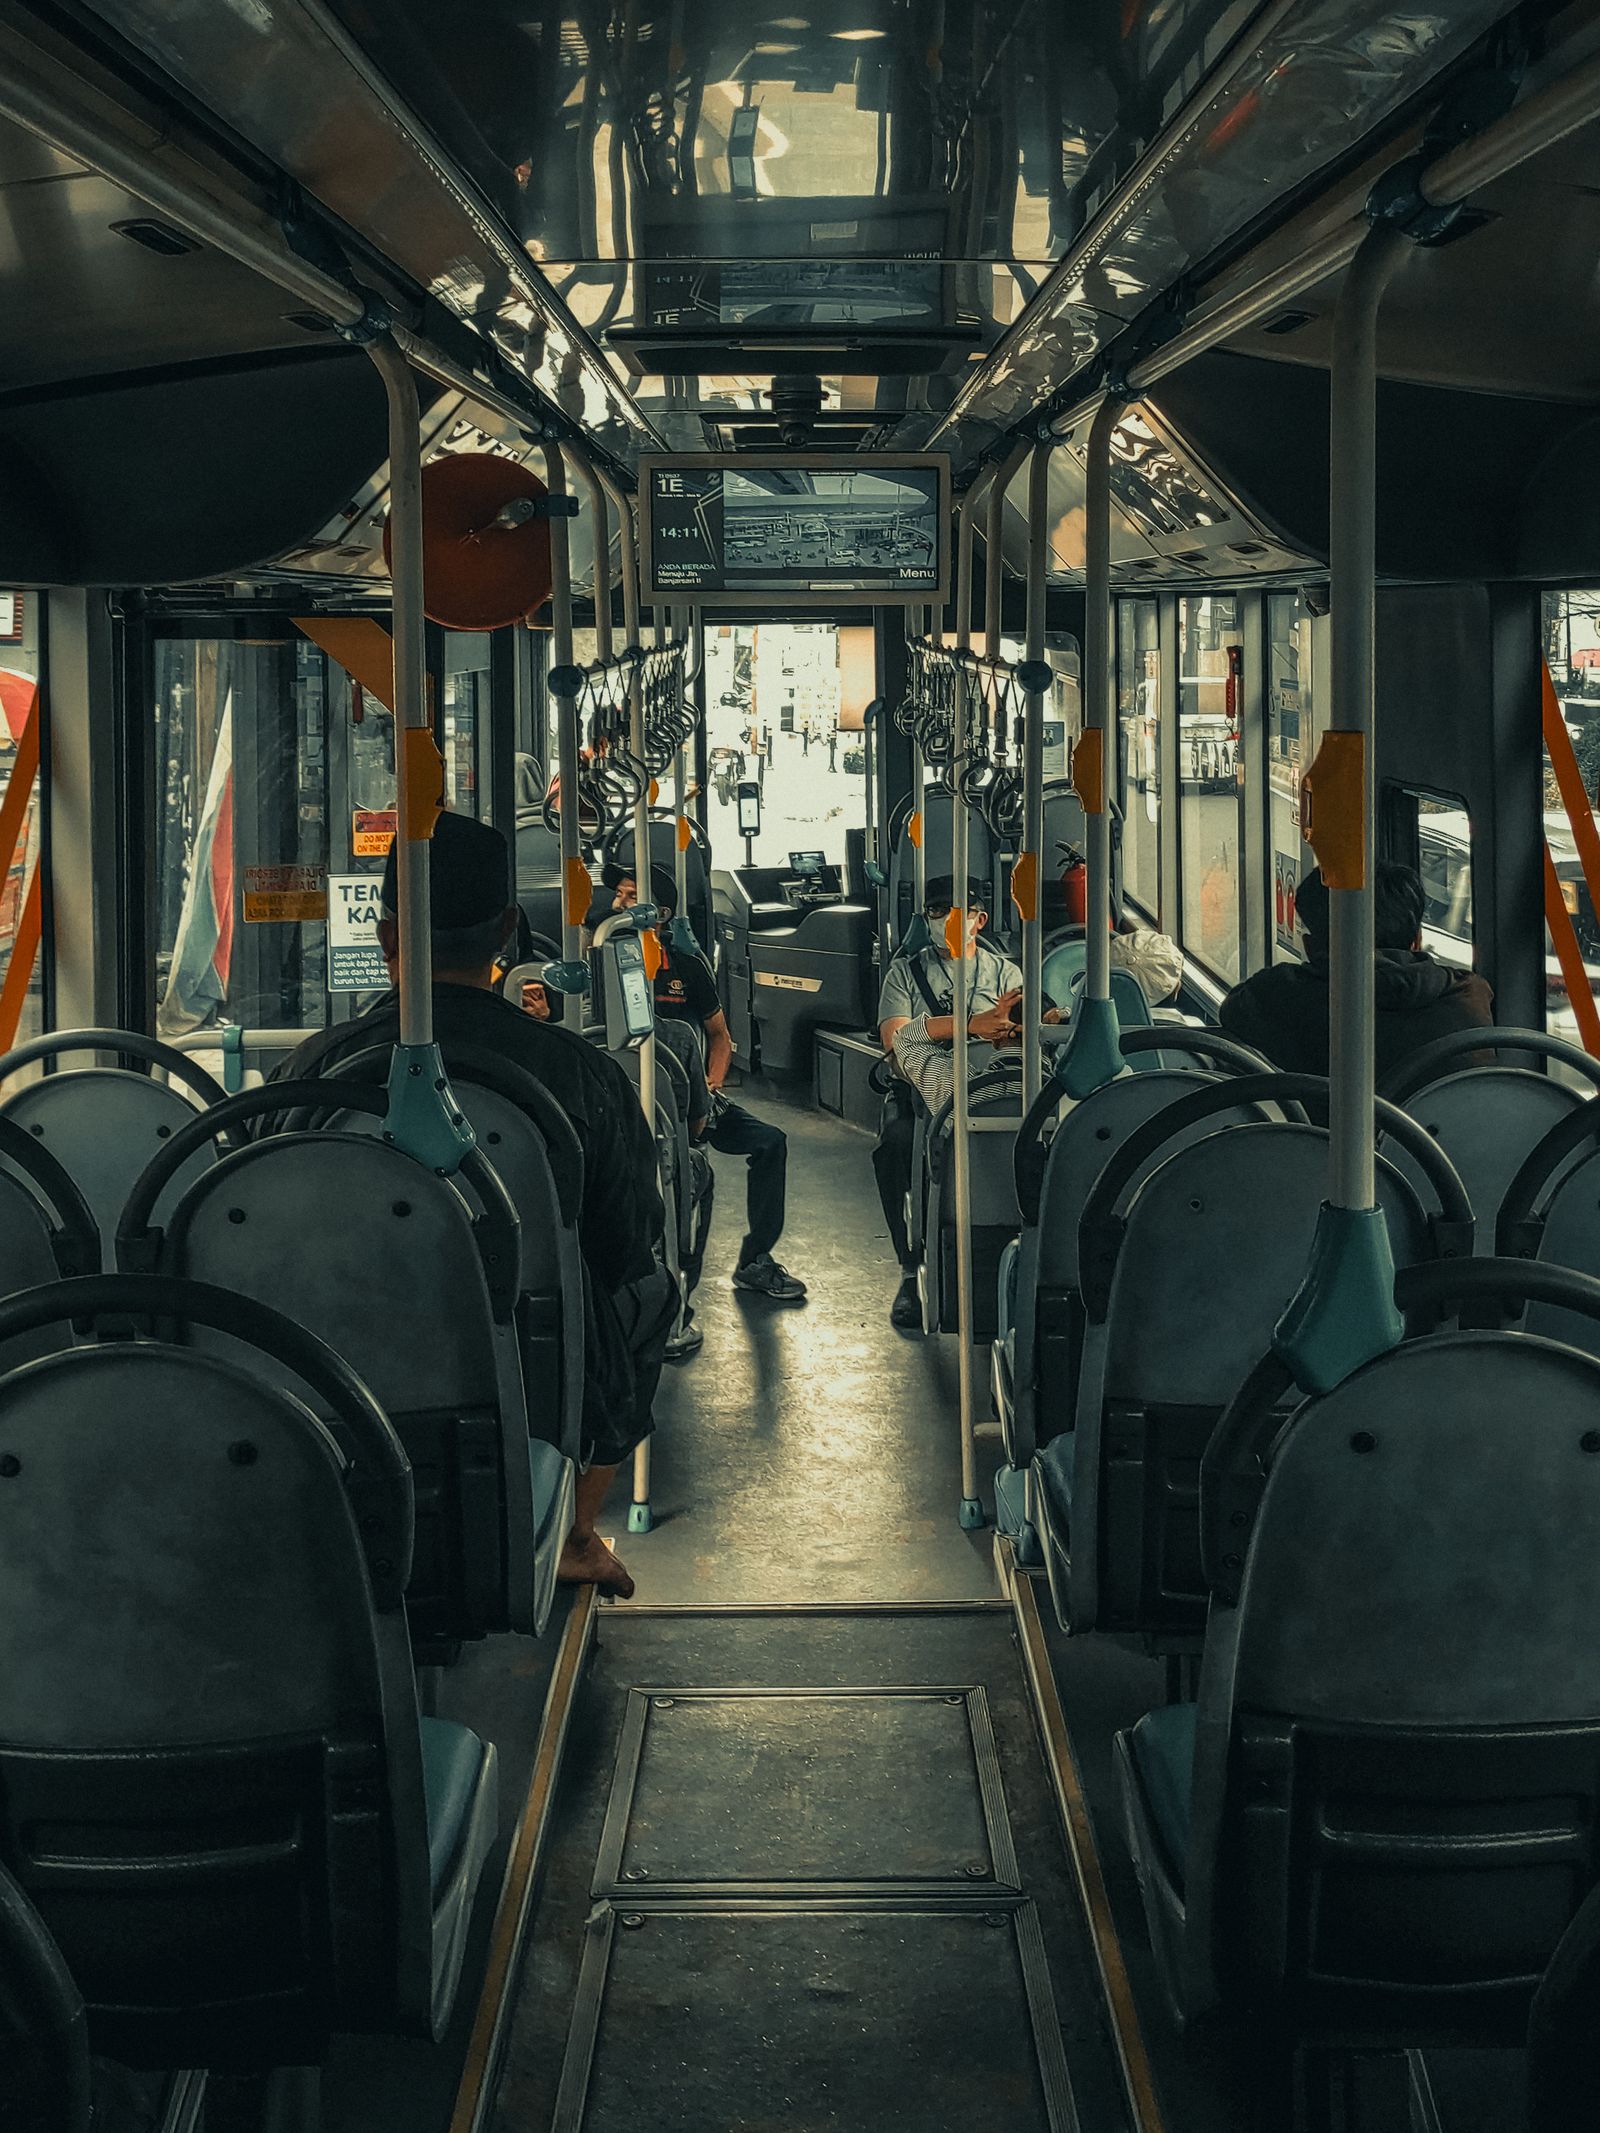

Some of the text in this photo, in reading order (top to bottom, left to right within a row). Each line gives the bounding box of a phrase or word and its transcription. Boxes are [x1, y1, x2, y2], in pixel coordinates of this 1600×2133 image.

[657, 479, 684, 493] 1E
[659, 526, 699, 538] 14:11
[899, 568, 935, 578] Menu
